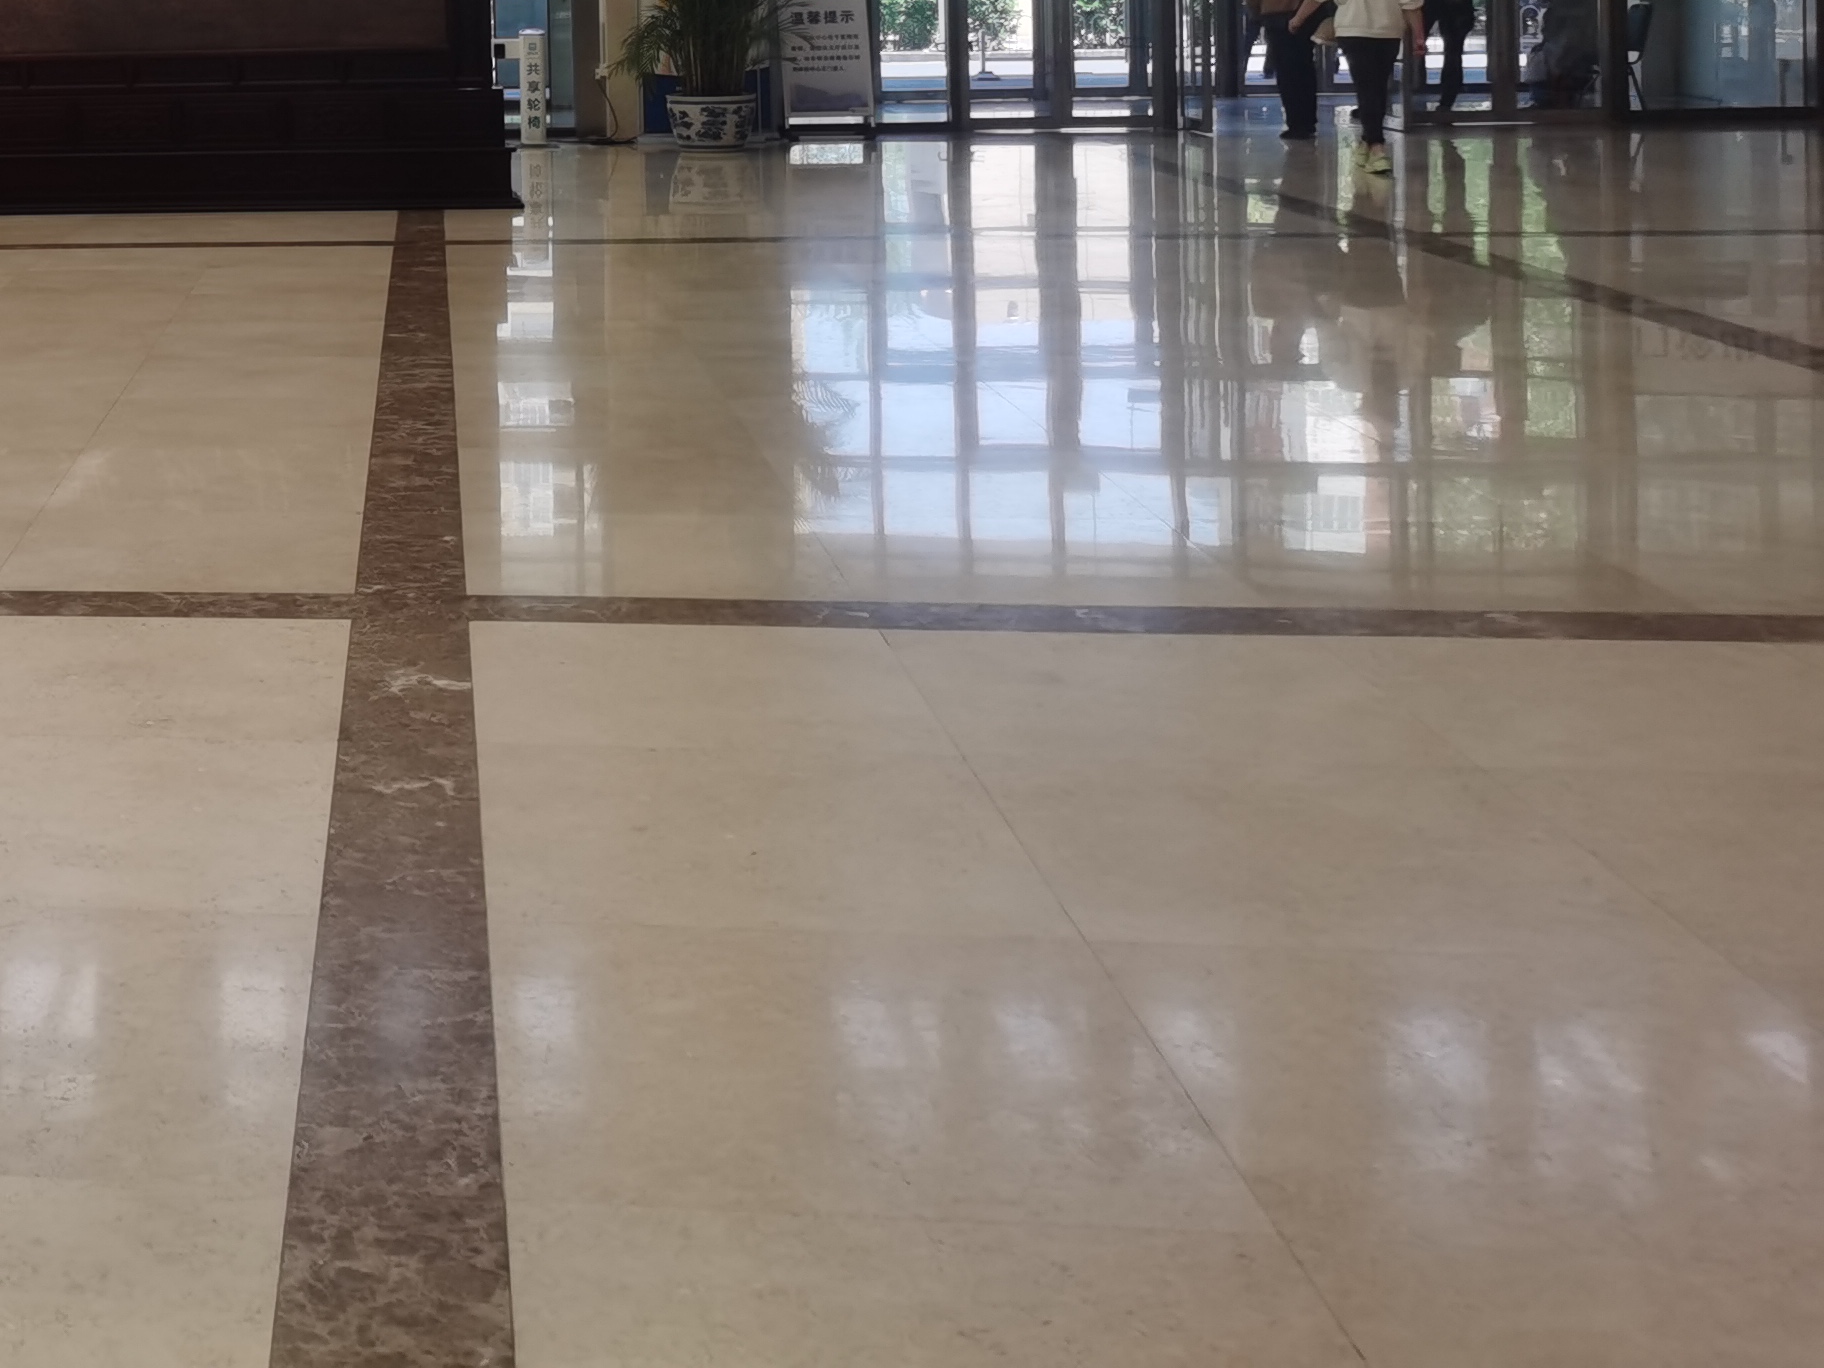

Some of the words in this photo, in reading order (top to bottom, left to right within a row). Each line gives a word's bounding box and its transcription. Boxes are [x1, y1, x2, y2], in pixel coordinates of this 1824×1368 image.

[790, 10, 855, 25] 温馨提示
[526, 62, 541, 129] 共享轮椅
